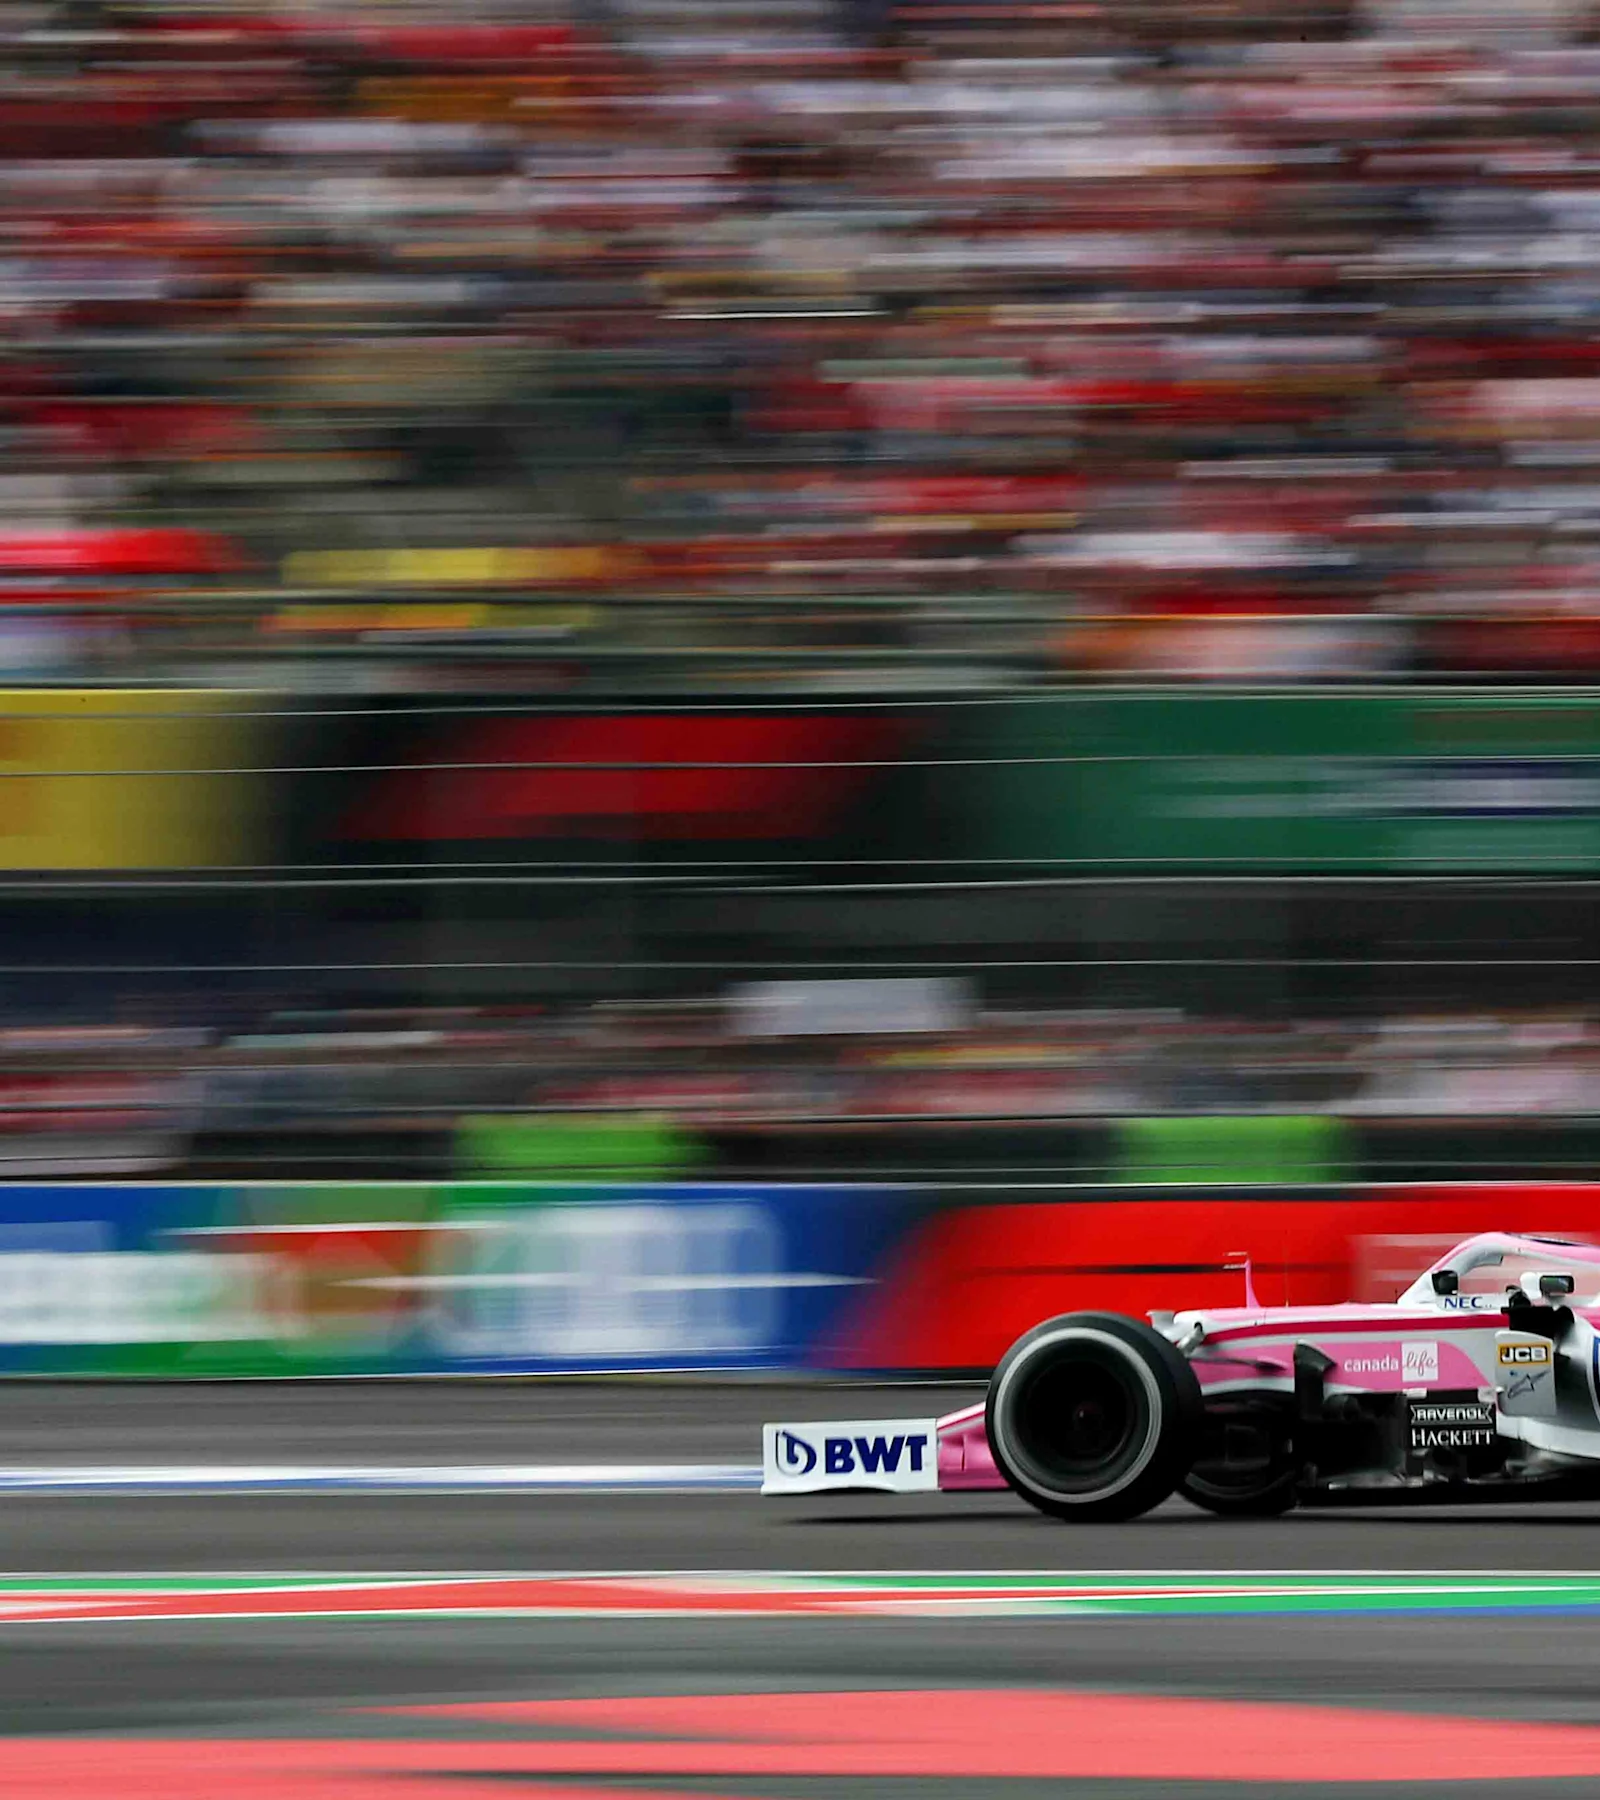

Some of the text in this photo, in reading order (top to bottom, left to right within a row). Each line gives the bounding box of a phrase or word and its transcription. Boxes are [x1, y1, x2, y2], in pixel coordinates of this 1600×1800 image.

[1444, 1296, 1483, 1309] NEC
[1344, 1346, 1437, 1376] canada life
[1502, 1347, 1548, 1363] JCB
[1416, 1407, 1485, 1420] RAVENOL
[1412, 1429, 1493, 1446] HACKETT
[825, 1435, 927, 1474] BWT
